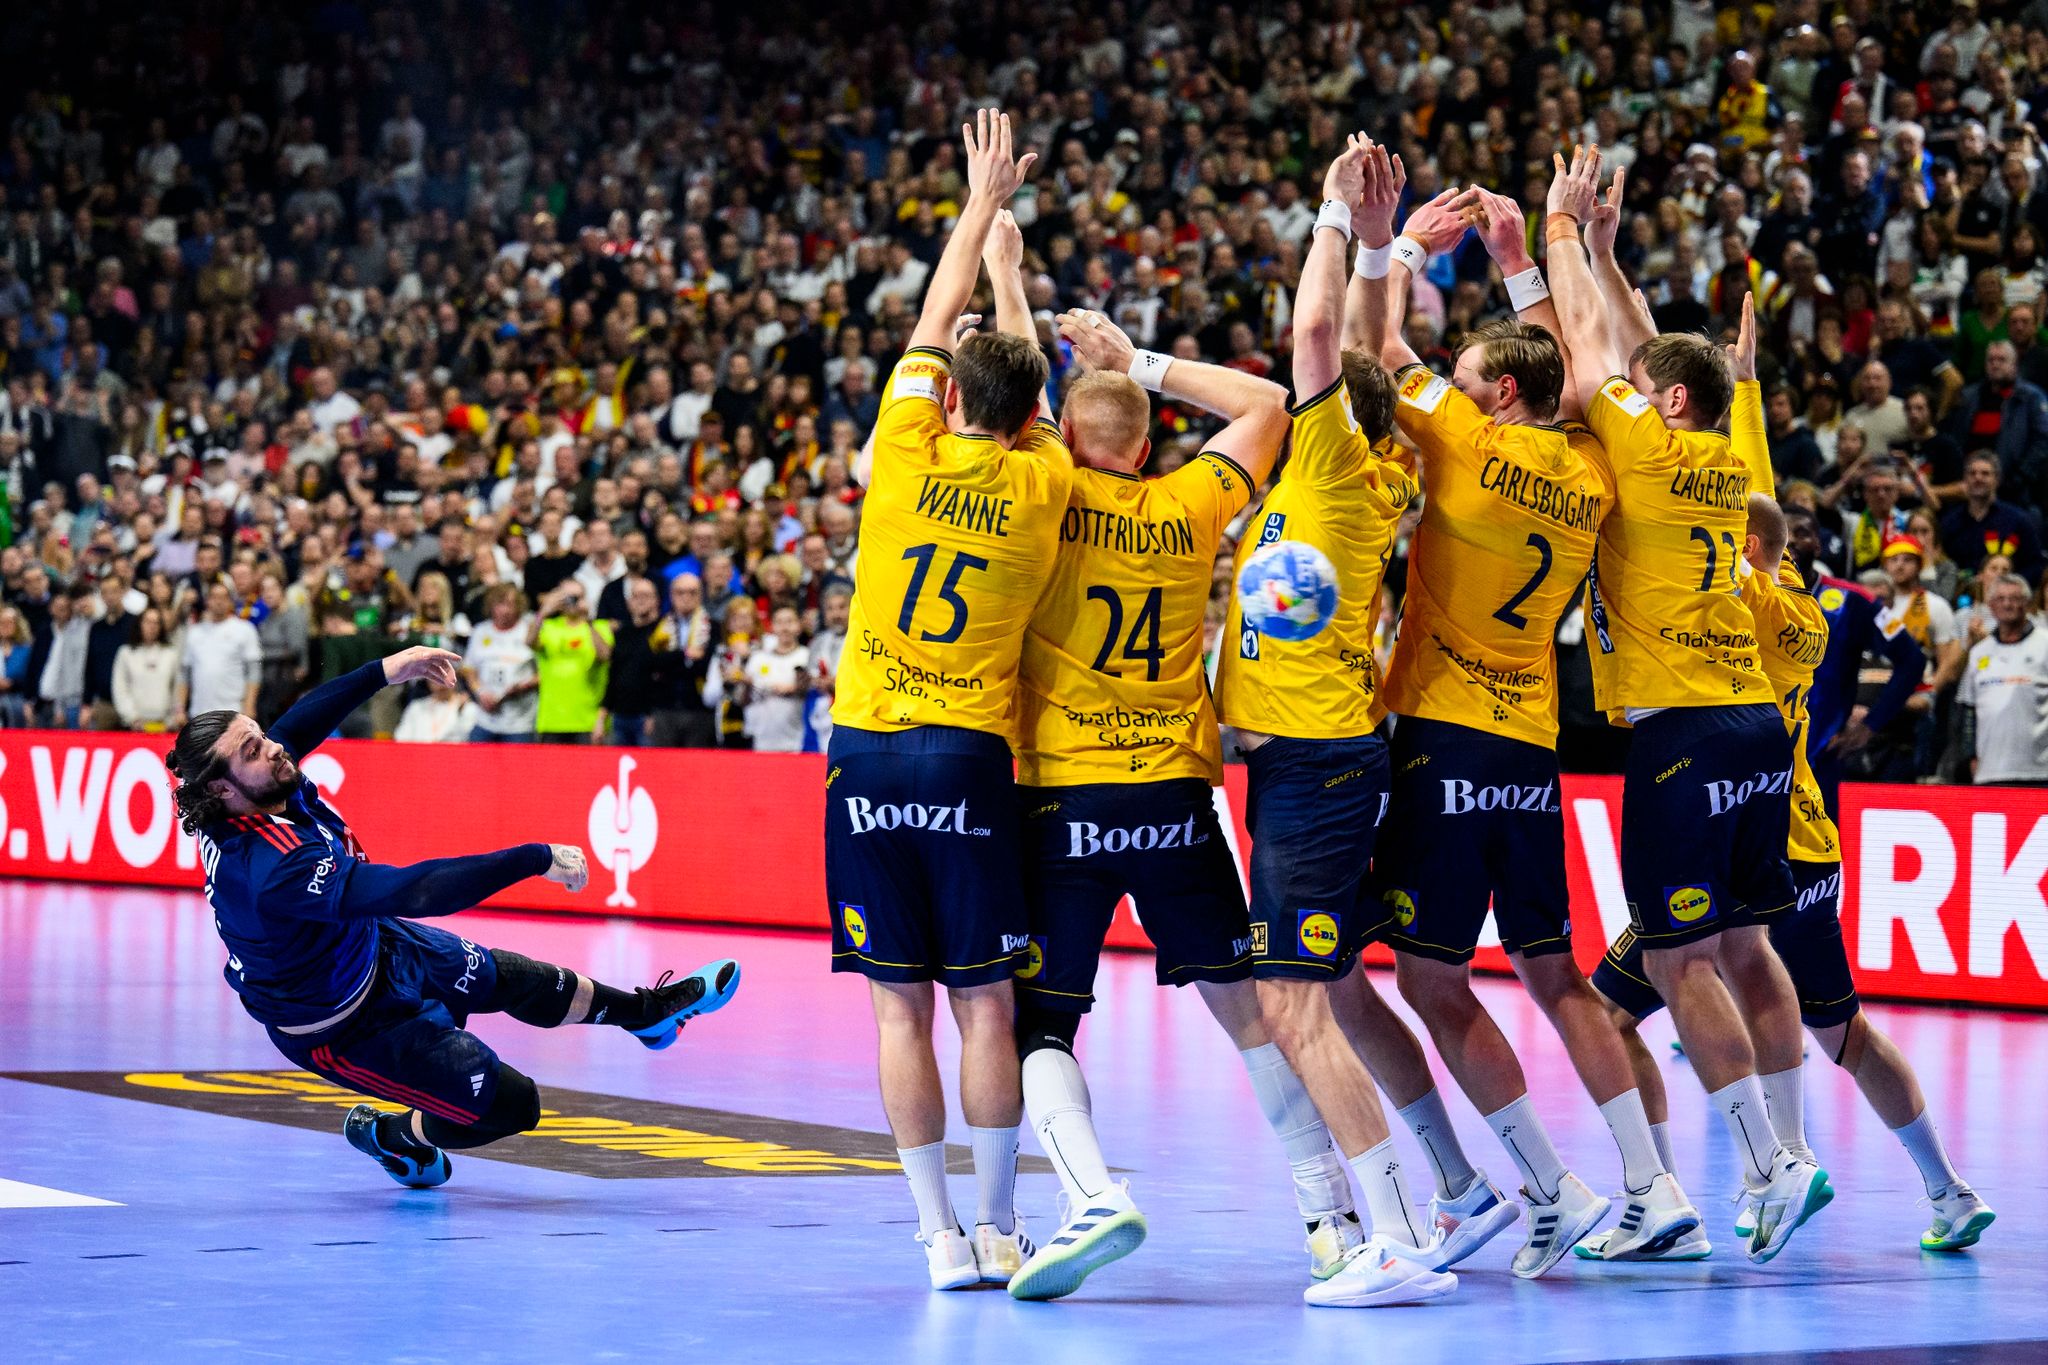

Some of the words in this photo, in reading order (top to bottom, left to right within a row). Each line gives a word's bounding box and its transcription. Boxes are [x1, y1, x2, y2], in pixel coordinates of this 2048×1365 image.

[915, 476, 1013, 538] WANNE
[1480, 456, 1600, 533] CARLSBOGÅRD
[1059, 505, 1195, 556] OTTFRIDSON
[897, 543, 989, 643] 15
[1492, 533, 1553, 631] 2
[1086, 585, 1166, 682] 24
[1324, 770, 1355, 788] CRAFT
[1655, 761, 1683, 783] CRAFT
